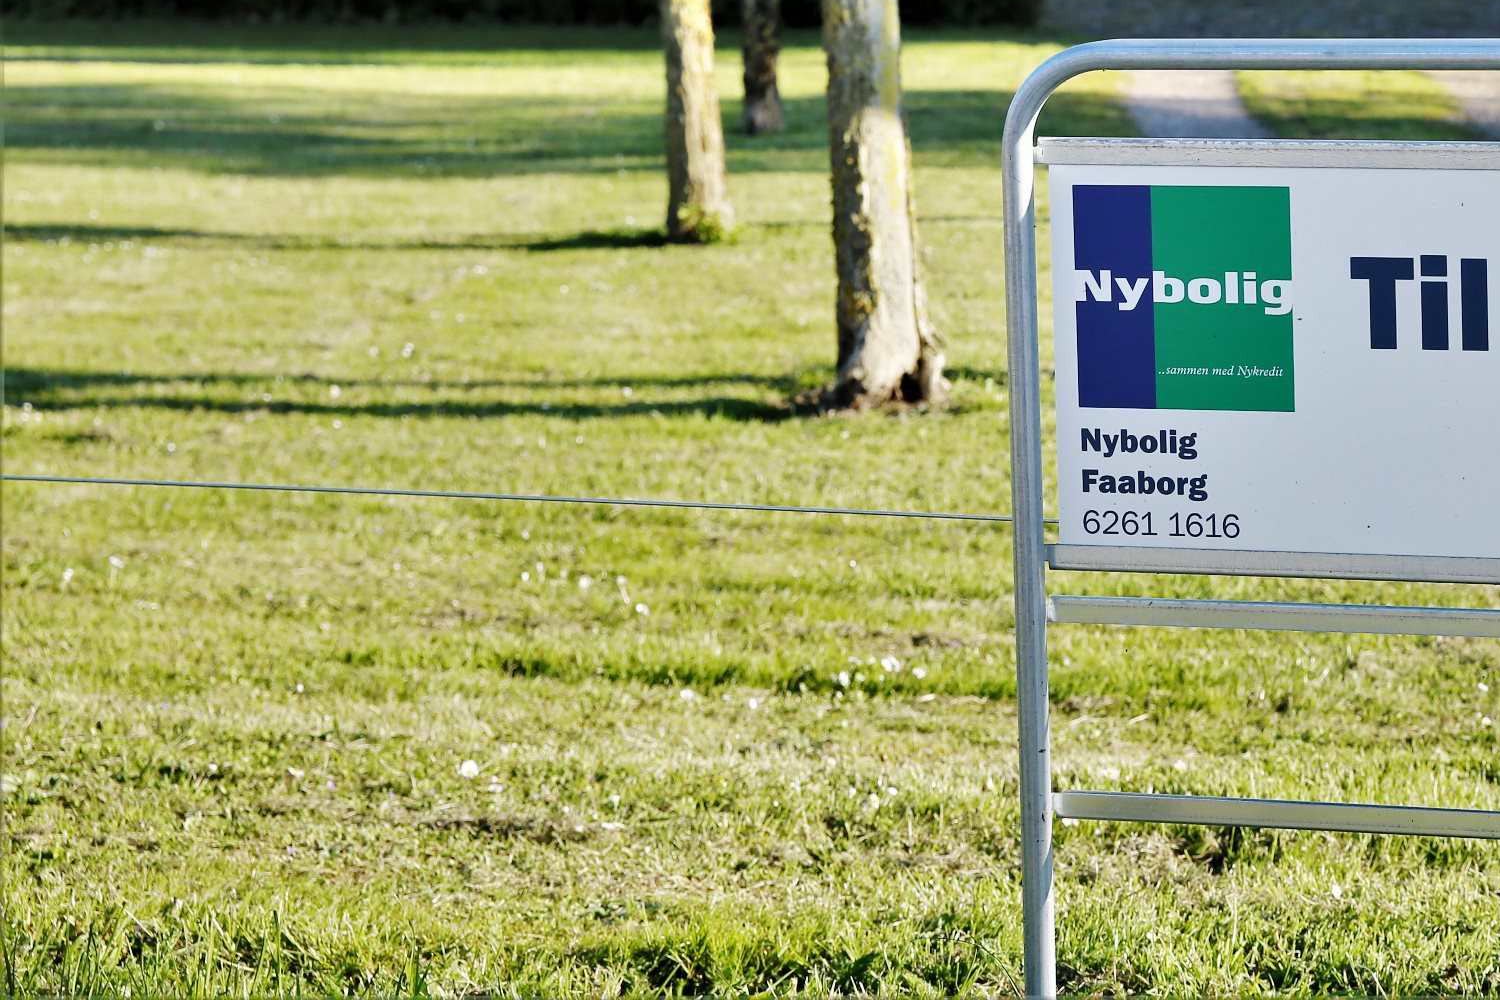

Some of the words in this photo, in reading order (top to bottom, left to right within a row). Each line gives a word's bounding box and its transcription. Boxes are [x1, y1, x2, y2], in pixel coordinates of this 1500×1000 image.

[1074, 268, 1293, 316] Nybolig
[1349, 254, 1490, 352] Til
[1211, 365, 1235, 376] med
[1236, 365, 1284, 379] Nykredit
[1080, 427, 1198, 461] Nybolig
[1081, 468, 1209, 502] Faaborg
[1082, 509, 1158, 536] 6261
[1168, 512, 1241, 539] 1616
